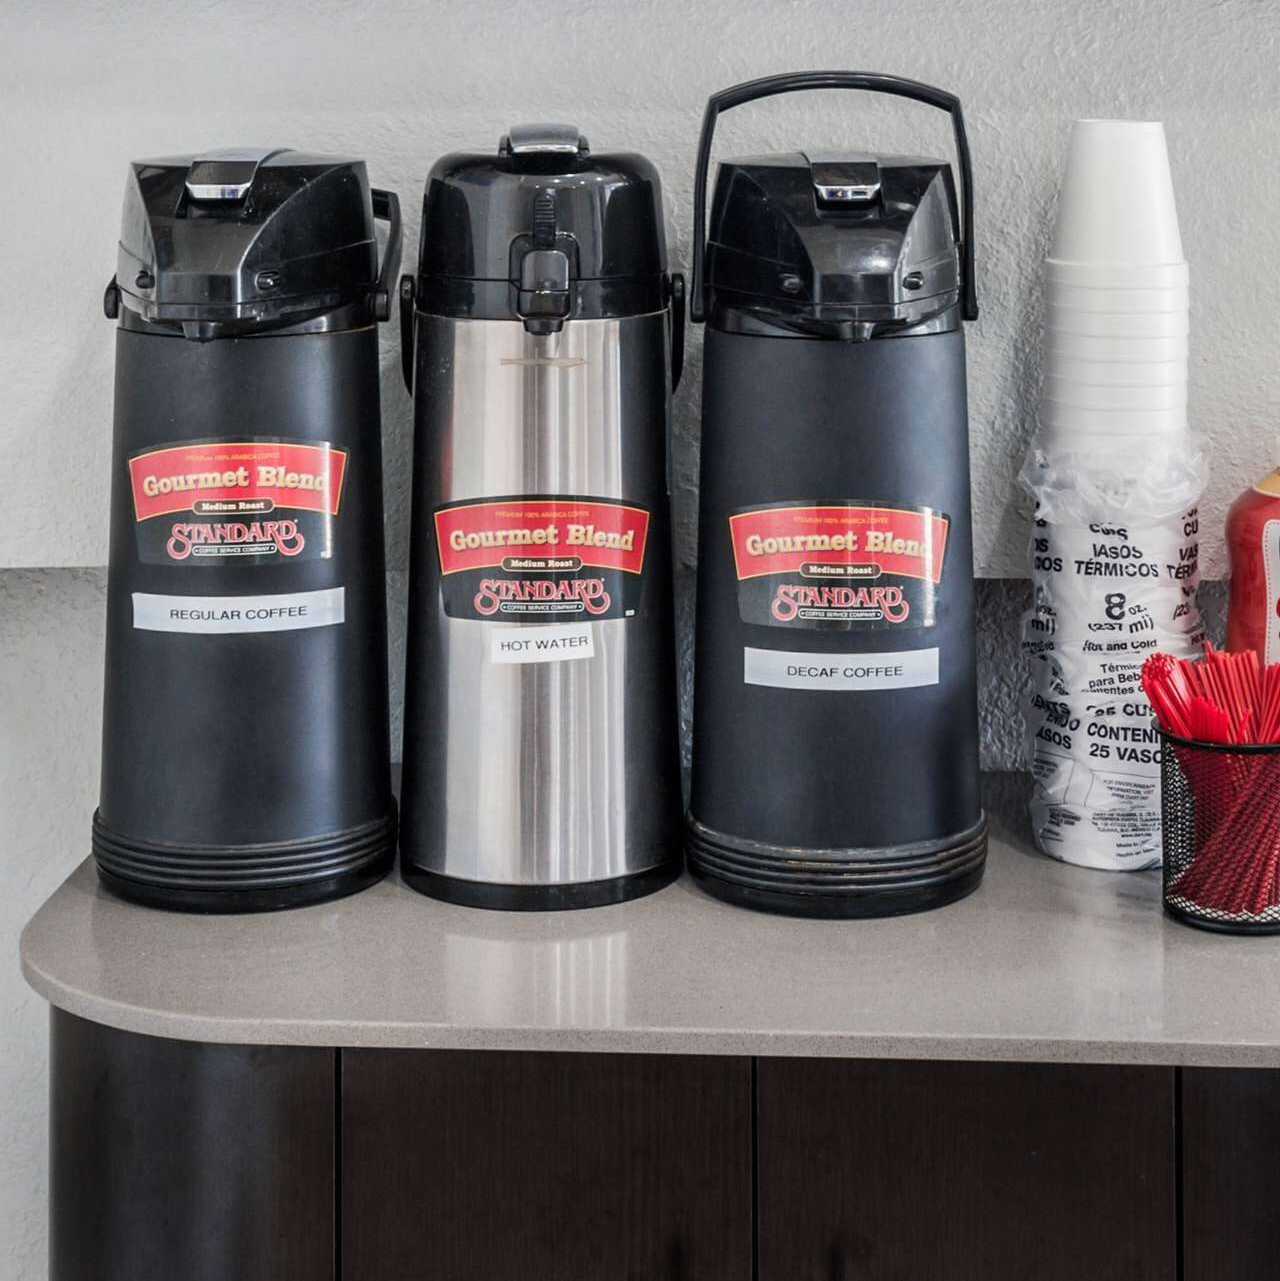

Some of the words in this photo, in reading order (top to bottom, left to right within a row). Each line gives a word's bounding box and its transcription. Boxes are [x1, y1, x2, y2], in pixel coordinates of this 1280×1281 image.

[143, 466, 250, 497] Gourmet
[201, 502, 236, 511] Medium
[239, 501, 264, 510] Roast
[167, 520, 305, 559] STANDARD
[449, 525, 560, 552] Gourmet
[566, 525, 635, 552] Blend
[745, 530, 859, 557] Gourmet
[510, 559, 546, 568] Medium
[548, 559, 573, 568] Roast
[809, 565, 844, 575] Medium
[847, 566, 873, 575] Roast
[1075, 559, 1159, 578] TÉRMICOS
[474, 577, 611, 616] STANDARD
[771, 584, 910, 623] STANDARD
[170, 608, 241, 621] REGULAR
[245, 605, 308, 620] COFFEE
[1104, 592, 1126, 621] 8
[500, 640, 531, 652] HOT
[535, 636, 589, 650] WATER
[786, 665, 839, 678] DECAF
[843, 665, 904, 678] COFFEE
[1088, 677, 1115, 689] para
[1089, 743, 1110, 758] 25
